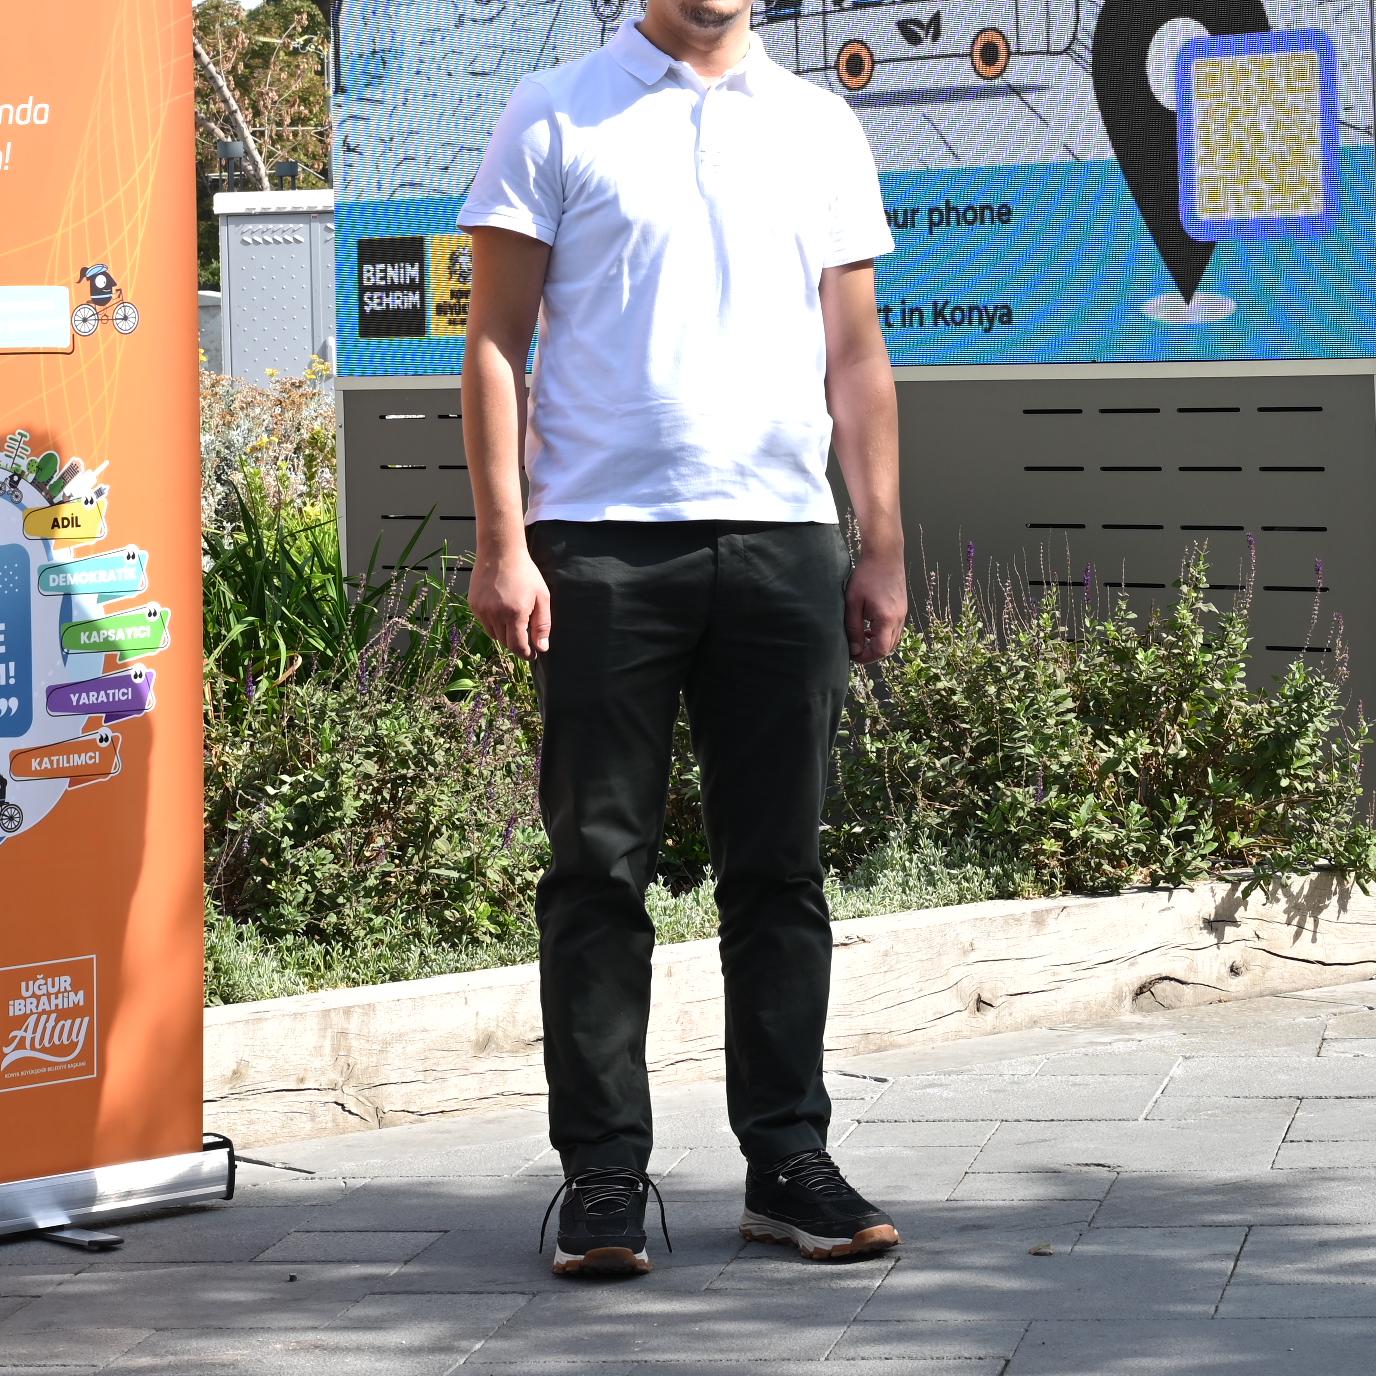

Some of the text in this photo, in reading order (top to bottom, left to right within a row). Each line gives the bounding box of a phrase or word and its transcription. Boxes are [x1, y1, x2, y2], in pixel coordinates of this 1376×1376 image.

[928, 199, 1012, 235] phone
[362, 262, 420, 285] BENİM
[900, 299, 924, 327] in
[932, 299, 1013, 333] Konya
[50, 512, 82, 530] ADİL
[79, 624, 152, 645] KAPSAYICI
[69, 687, 132, 707] YARATICI
[31, 750, 100, 771] KATILIMCI
[21, 974, 72, 998] UĞUR
[8, 990, 84, 1016] İBRAHİM
[1, 1013, 89, 1070] Altay
